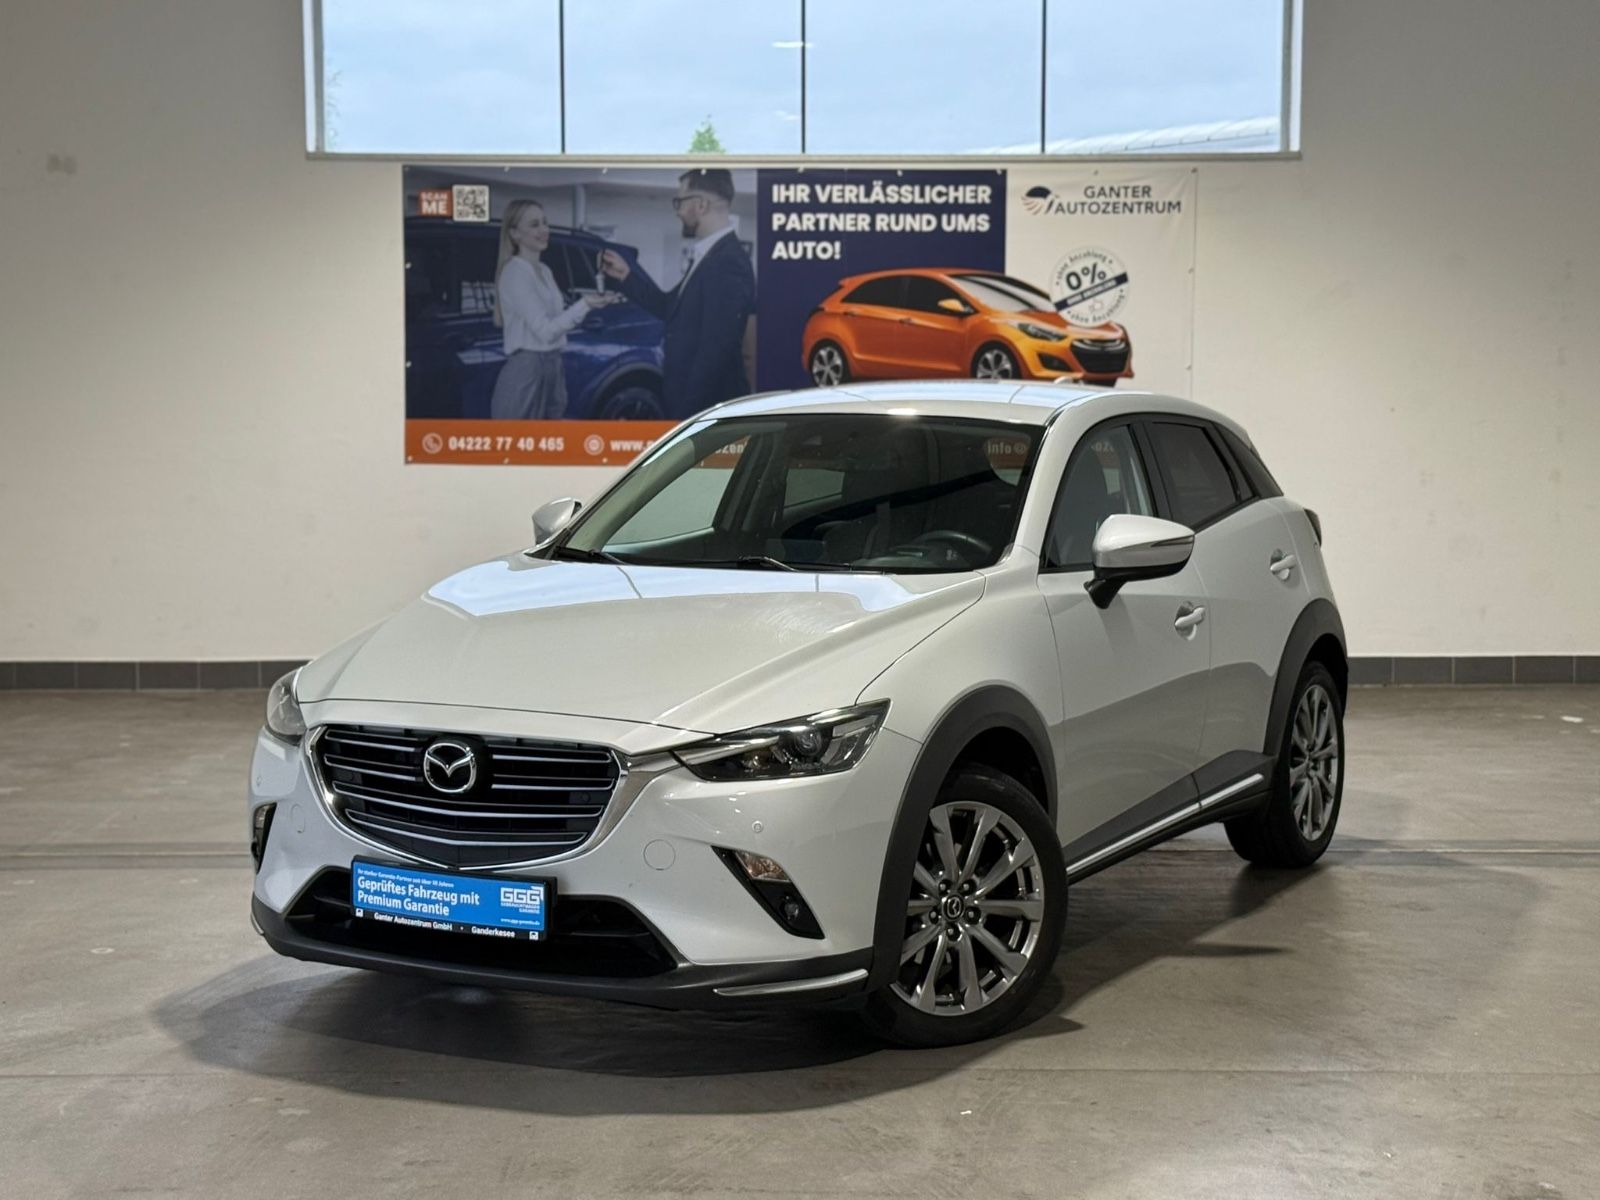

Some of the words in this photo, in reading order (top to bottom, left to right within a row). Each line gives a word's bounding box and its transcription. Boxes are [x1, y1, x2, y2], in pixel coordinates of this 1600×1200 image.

[420, 191, 448, 200] SCAN
[771, 184, 810, 203] IHR
[815, 180, 992, 204] VERLÄSSLICHER
[1083, 185, 1152, 199] GANTER
[421, 200, 448, 215] ME
[1054, 201, 1182, 215] AUTOZENTRUM
[771, 213, 871, 232] PARTNER
[875, 213, 938, 232] RUND
[941, 214, 991, 232] UMS
[771, 240, 841, 260] AUTO!
[1065, 262, 1107, 291] 0%
[448, 436, 492, 451] 04222
[496, 436, 513, 451] 77
[517, 436, 535, 451] 40
[538, 436, 565, 451] 465
[357, 876, 407, 895] Geprüftes
[407, 884, 458, 906] Fahrzeug
[460, 892, 480, 906] mit
[500, 886, 541, 905] GGG
[357, 890, 402, 909] Premium
[403, 898, 450, 916] Garantie
[373, 912, 394, 921] Ganter
[394, 916, 432, 928] Autozentrum
[432, 921, 453, 931] GmbH
[471, 926, 516, 938] Ganderkesee
